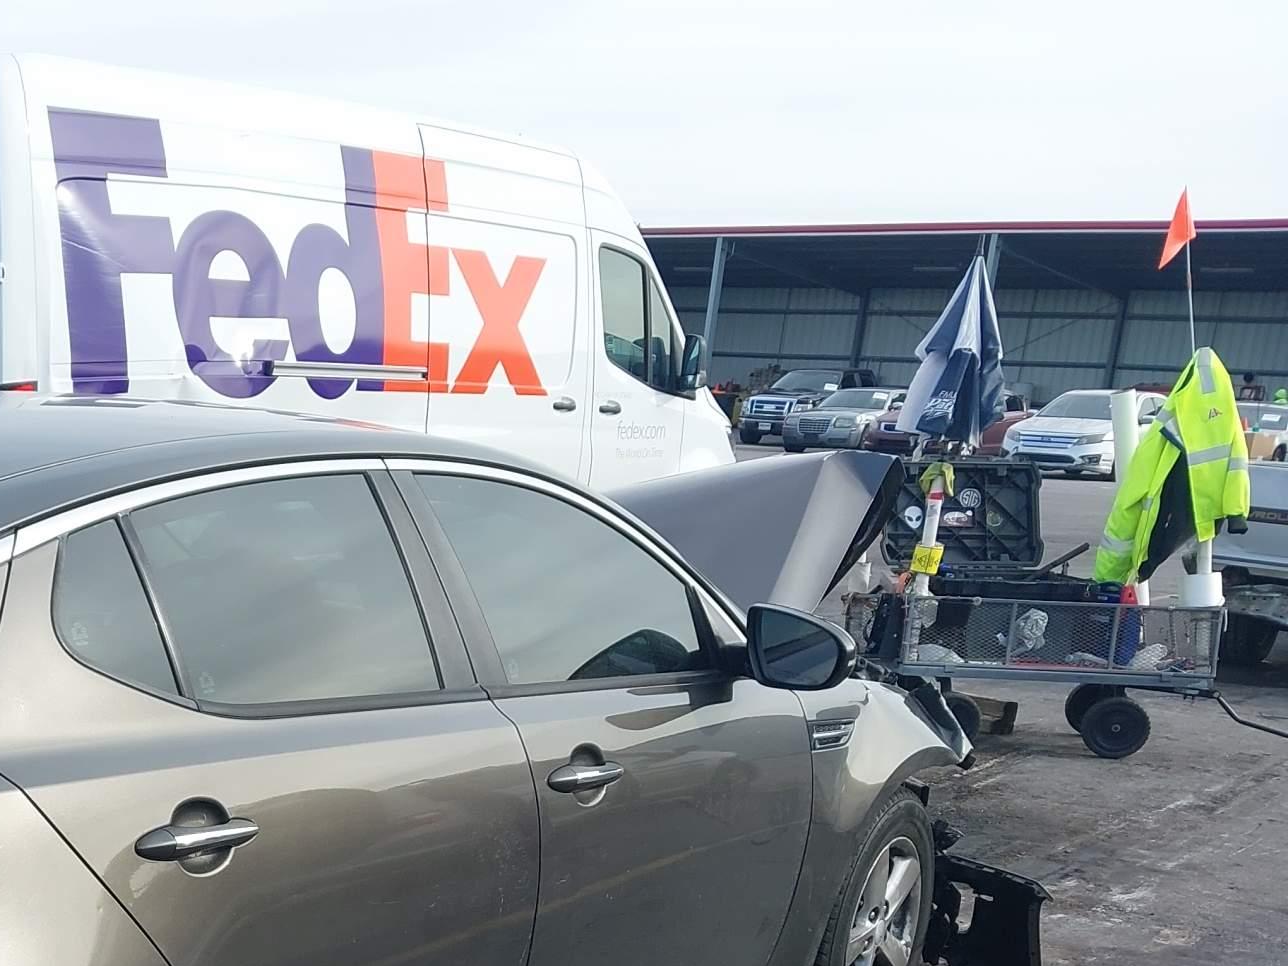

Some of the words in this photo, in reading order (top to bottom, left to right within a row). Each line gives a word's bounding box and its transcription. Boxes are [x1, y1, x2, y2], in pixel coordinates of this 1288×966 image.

[47, 104, 548, 401] FedEx
[617, 420, 666, 440] fedex.com
[961, 490, 980, 507] SIG
